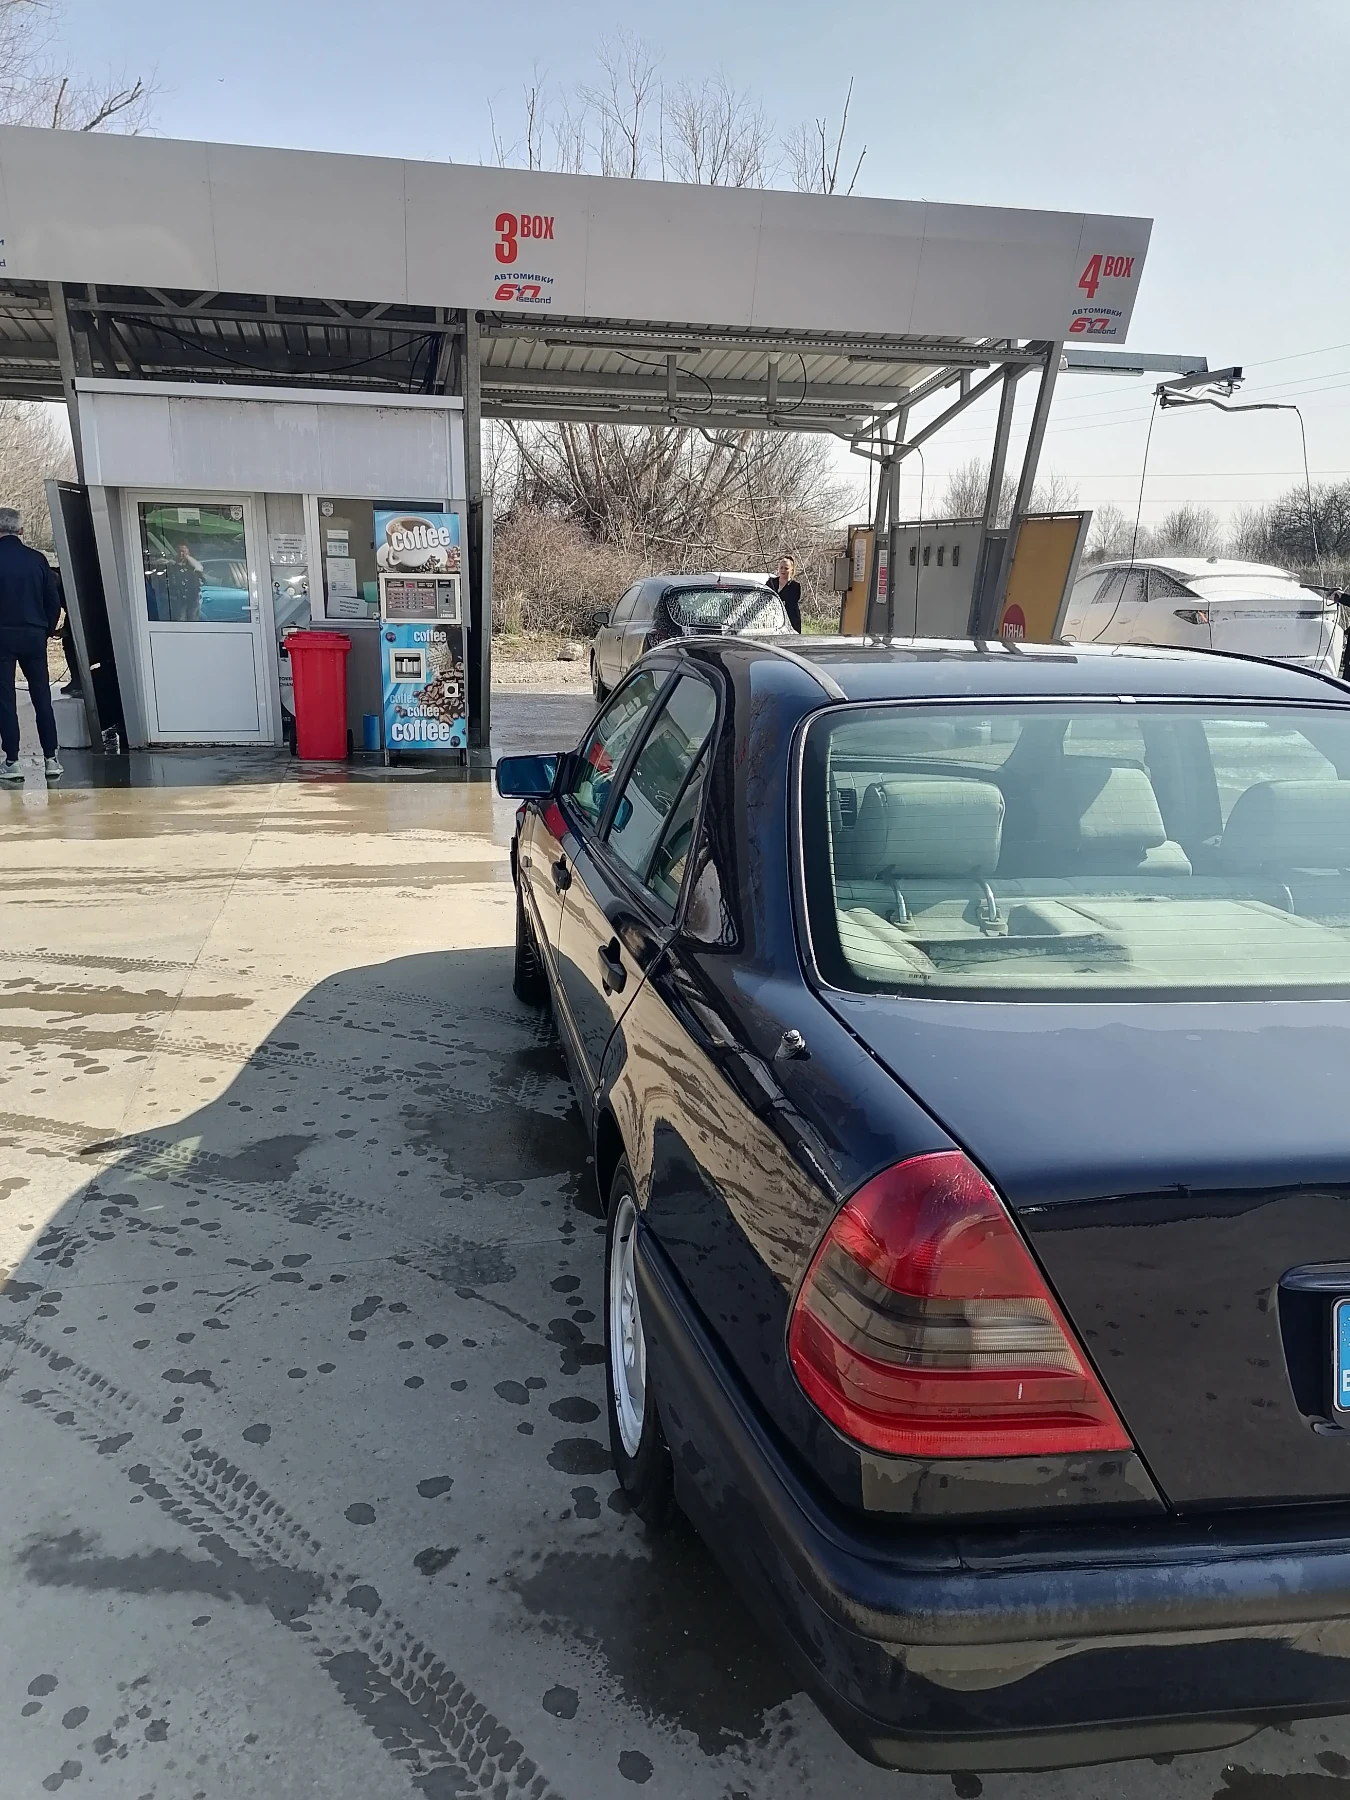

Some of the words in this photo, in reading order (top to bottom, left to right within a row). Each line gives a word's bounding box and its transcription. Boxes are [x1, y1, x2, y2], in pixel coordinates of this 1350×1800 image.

[495, 212, 518, 264] 3
[520, 214, 555, 240] BOX
[494, 272, 554, 285] АВТОМИВКИ
[1078, 254, 1104, 299] 4
[1103, 256, 1136, 278] BOX
[517, 295, 552, 305] second
[1071, 307, 1123, 318] АВТОМИВКИ
[392, 525, 451, 552] coffee
[413, 629, 447, 643] coffee
[1003, 622, 1025, 639] ПЯНА
[407, 704, 441, 718] coffee
[391, 719, 451, 742] coffee
